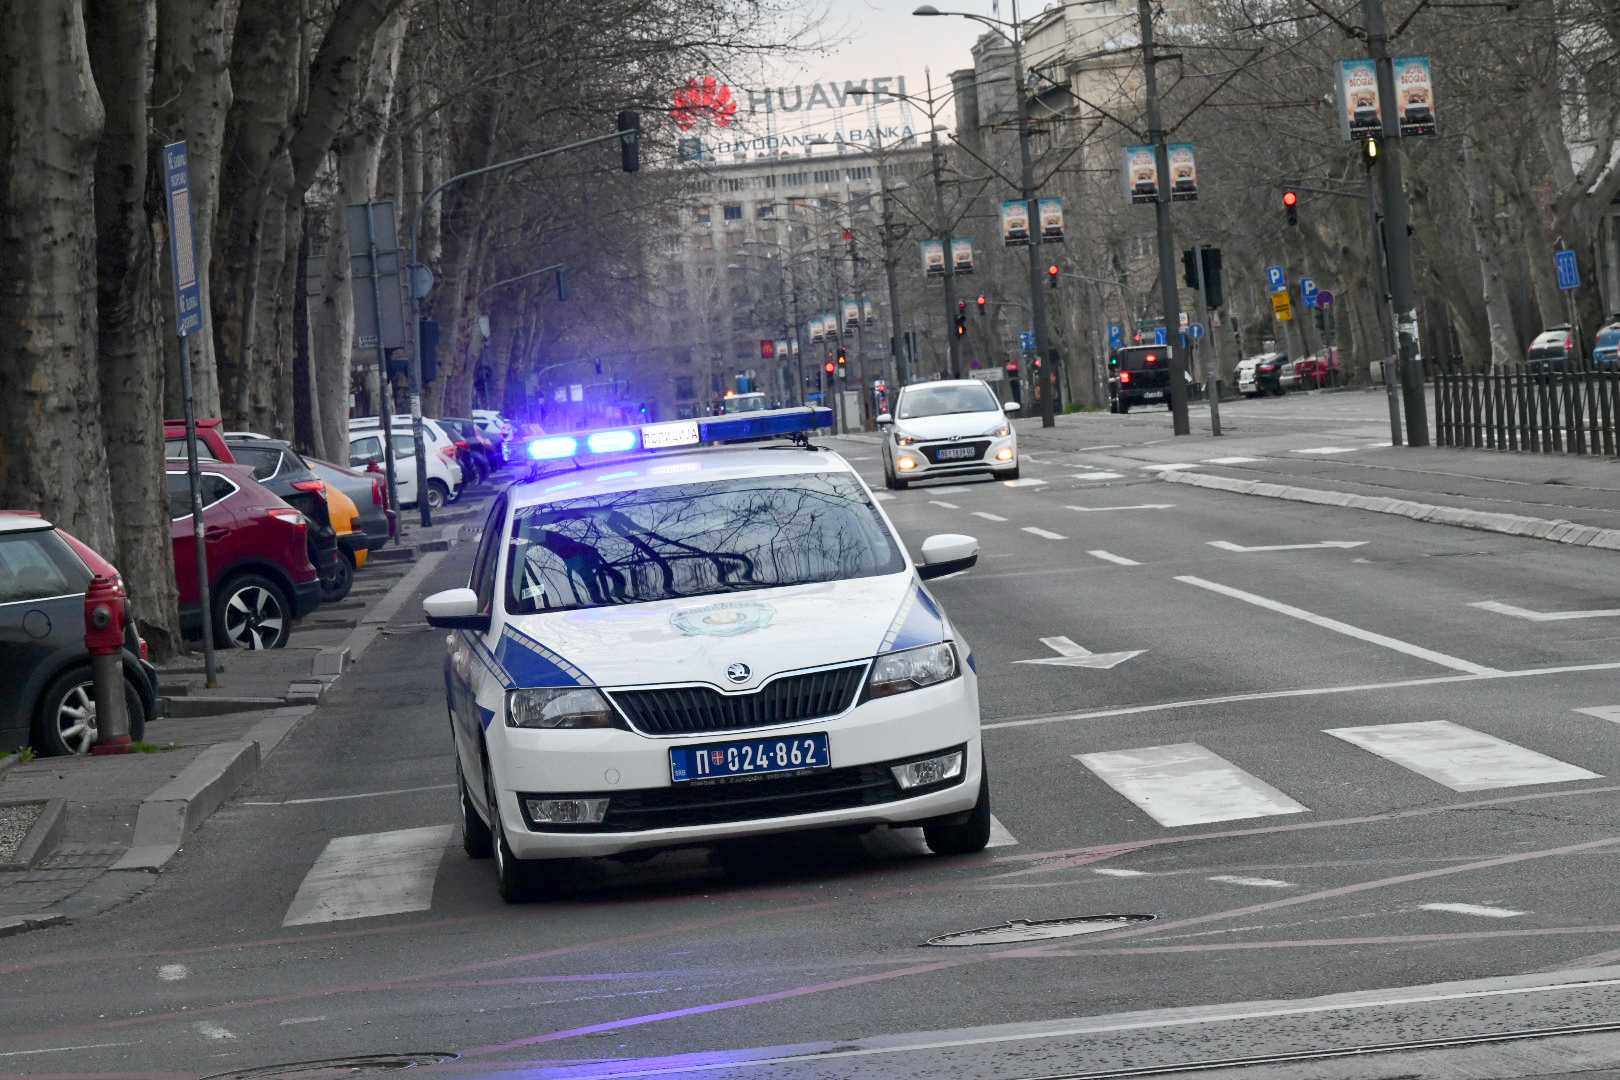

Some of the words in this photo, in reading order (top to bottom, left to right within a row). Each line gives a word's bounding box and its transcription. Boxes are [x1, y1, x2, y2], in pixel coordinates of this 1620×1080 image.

[1353, 69, 1370, 77] HOTEL
[1406, 66, 1423, 75] HOTEL
[1350, 78, 1374, 87] BEOGRAD
[1401, 75, 1427, 84] BEOGRAD
[748, 76, 905, 116] HUAWEI
[849, 125, 914, 141] BANKA
[1269, 268, 1281, 284] P
[1304, 280, 1316, 296] P
[1111, 326, 1120, 337] P
[644, 428, 698, 444] ПОЛИЦИЈА
[674, 769, 686, 777] SRB
